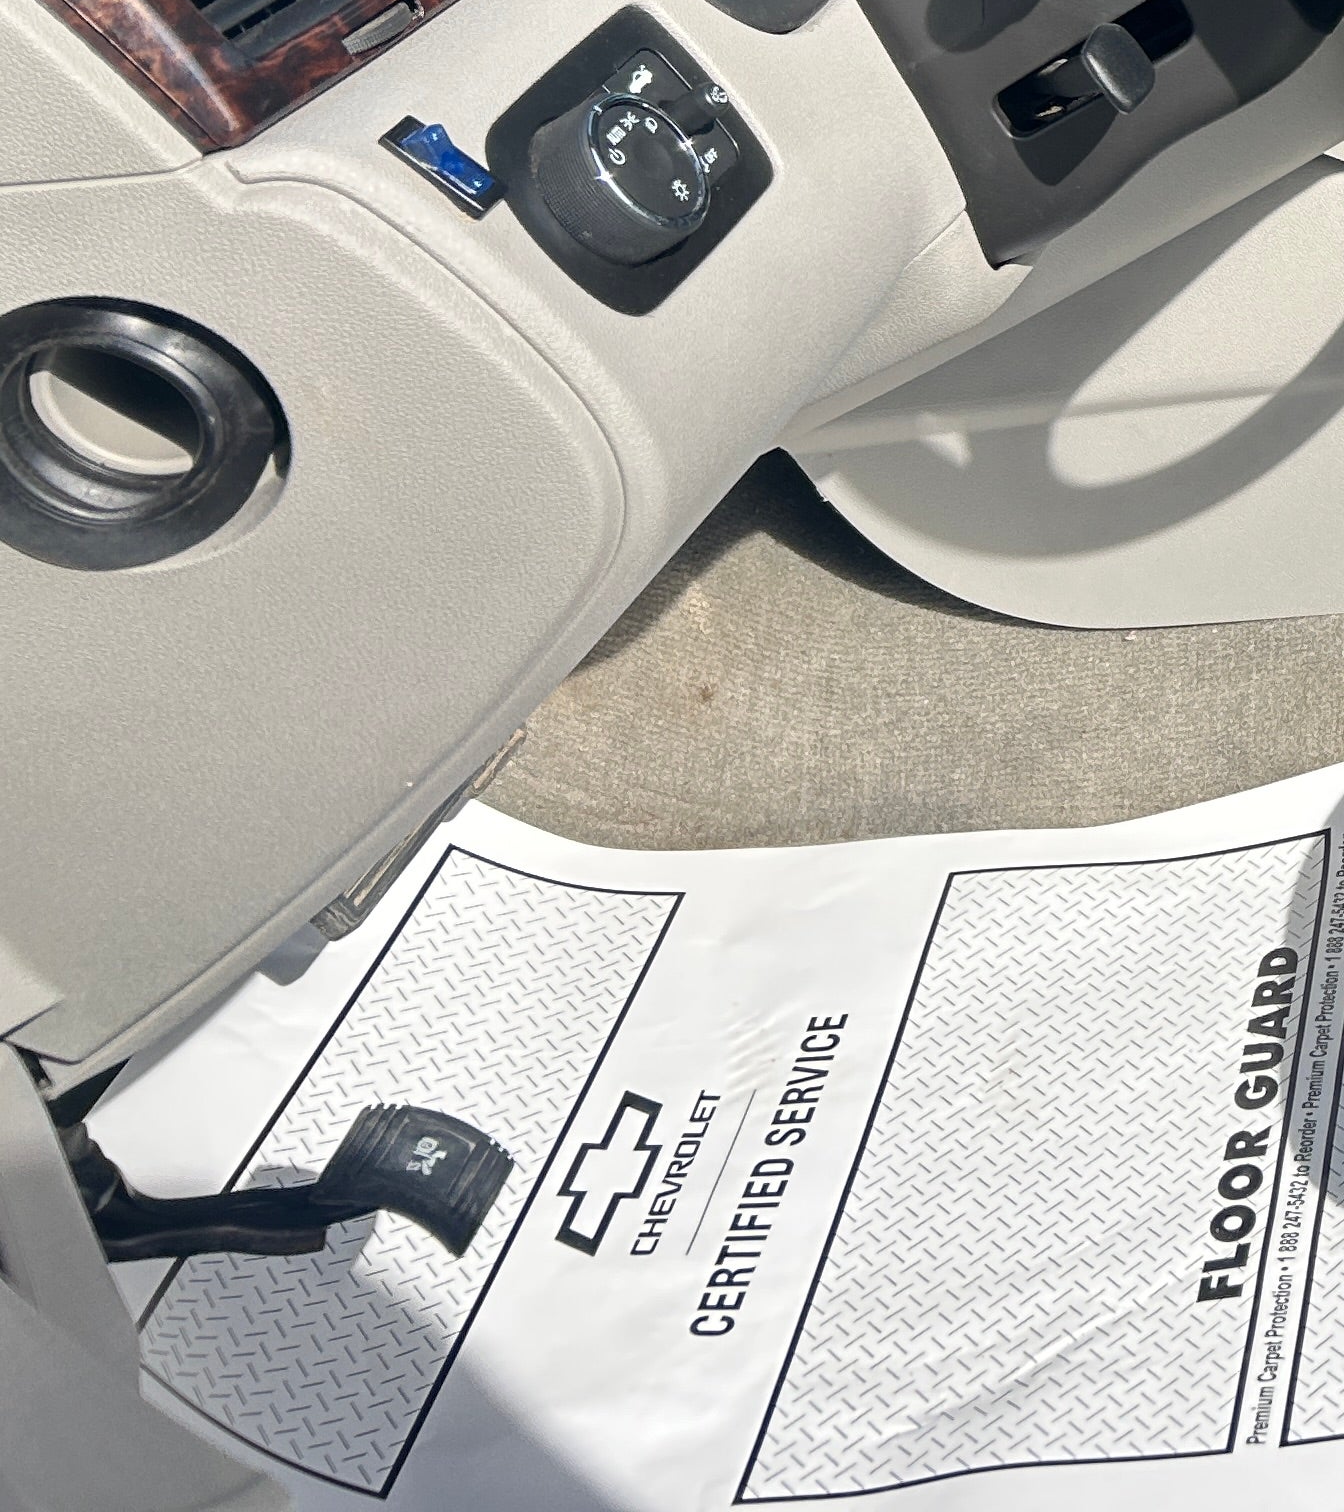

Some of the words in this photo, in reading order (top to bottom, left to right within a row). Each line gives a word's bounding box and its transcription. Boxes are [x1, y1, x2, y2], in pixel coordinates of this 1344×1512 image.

[1326, 935, 1344, 954] 888
[1315, 971, 1339, 1022] Protection
[1309, 1021, 1334, 1057] Carpet
[1302, 1060, 1325, 1109] Premium
[1196, 1125, 1272, 1303] FLOOR
[1234, 947, 1299, 1110] GUARD
[1294, 1119, 1317, 1162] Reorder
[630, 1089, 721, 1256] CHEVROLET
[689, 1158, 795, 1337] CERTIFIED
[764, 1013, 849, 1147] SERVICE
[1293, 1165, 1310, 1179] to
[1283, 1180, 1309, 1229] 247-5432
[1278, 1231, 1299, 1253] 888
[1264, 1274, 1293, 1338] Protection
[1257, 1340, 1285, 1382] Carpet
[1246, 1386, 1275, 1445] Premium
